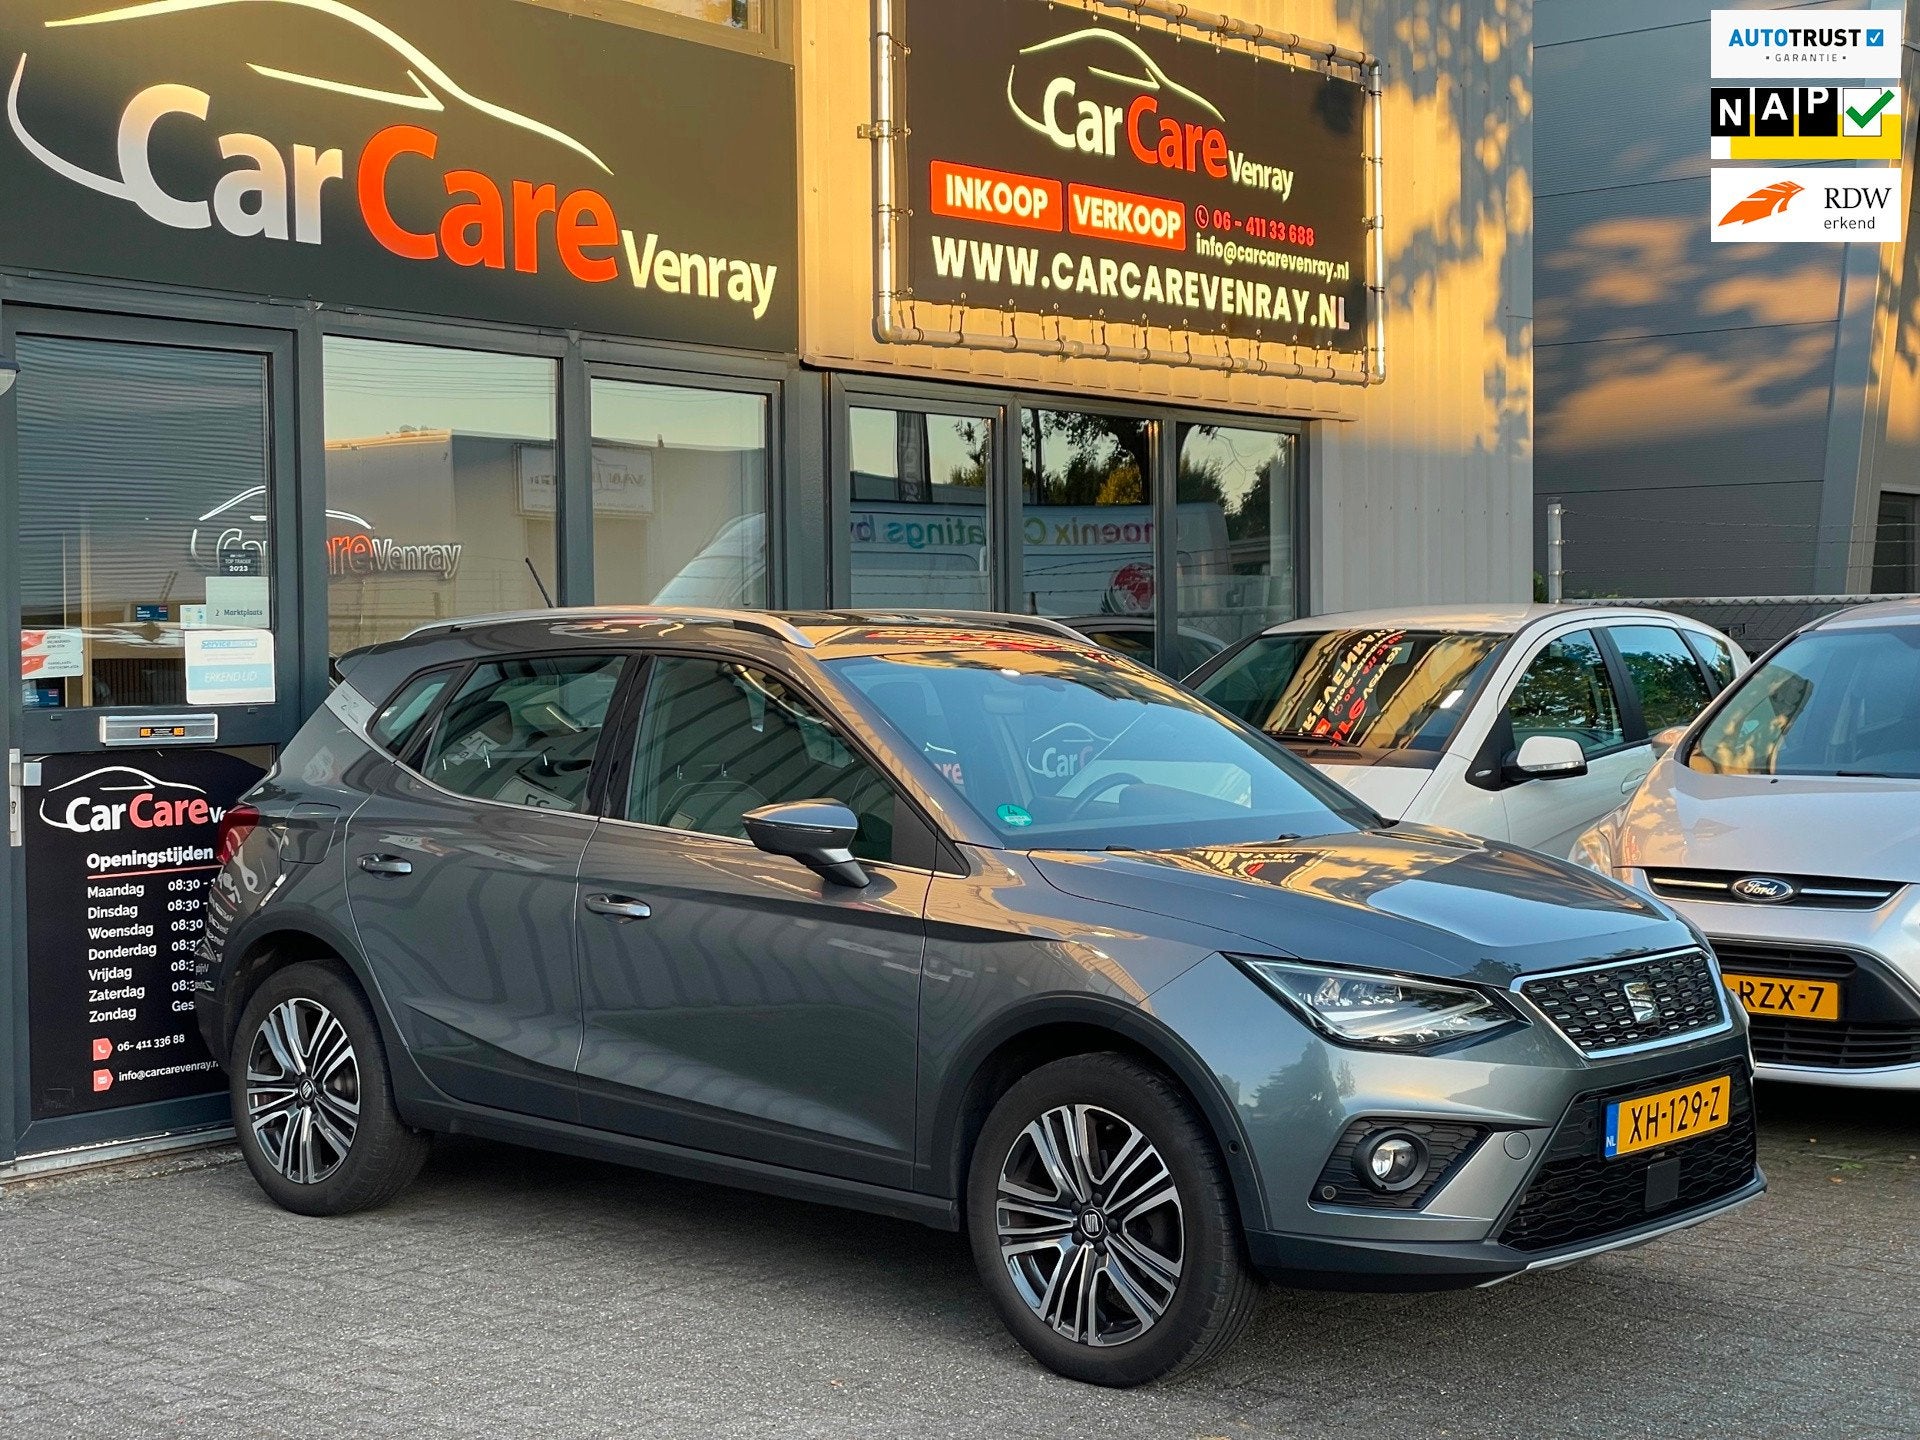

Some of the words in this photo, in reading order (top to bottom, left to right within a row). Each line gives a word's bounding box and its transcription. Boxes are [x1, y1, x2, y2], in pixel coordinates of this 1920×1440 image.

[1228, 149, 1295, 203] Venray
[944, 173, 1049, 219] INKOOP
[1072, 193, 1182, 240] VERKOOP
[1213, 208, 1232, 231] 06
[1245, 216, 1267, 238] 411
[1268, 221, 1287, 242] 33
[1288, 225, 1315, 247] 688
[1195, 232, 1350, 283] info@carcarevenray.nl
[621, 228, 778, 320] Venray
[931, 235, 1351, 331] WWW.CARCAREVENRAY.NL
[224, 608, 263, 618] Marktplaats
[86, 846, 214, 872] Openingstijden
[87, 882, 145, 899] Maandag
[167, 878, 200, 893] 08:30
[1743, 878, 1780, 898] Ford
[87, 904, 138, 921] Dinsdag
[167, 898, 200, 912] 08:30
[87, 922, 154, 941] Woensdag
[170, 917, 203, 932] 08:30
[88, 943, 157, 962] Donderdag
[88, 965, 133, 983] Vrijdag
[88, 985, 146, 1003] Zaterdag
[88, 1007, 137, 1024] Zondag
[136, 1039, 152, 1051] 411
[153, 1036, 171, 1048] 336
[172, 1033, 185, 1044] 88
[1629, 1086, 1722, 1144] XH-129-Z
[1605, 1133, 1617, 1148] NL
